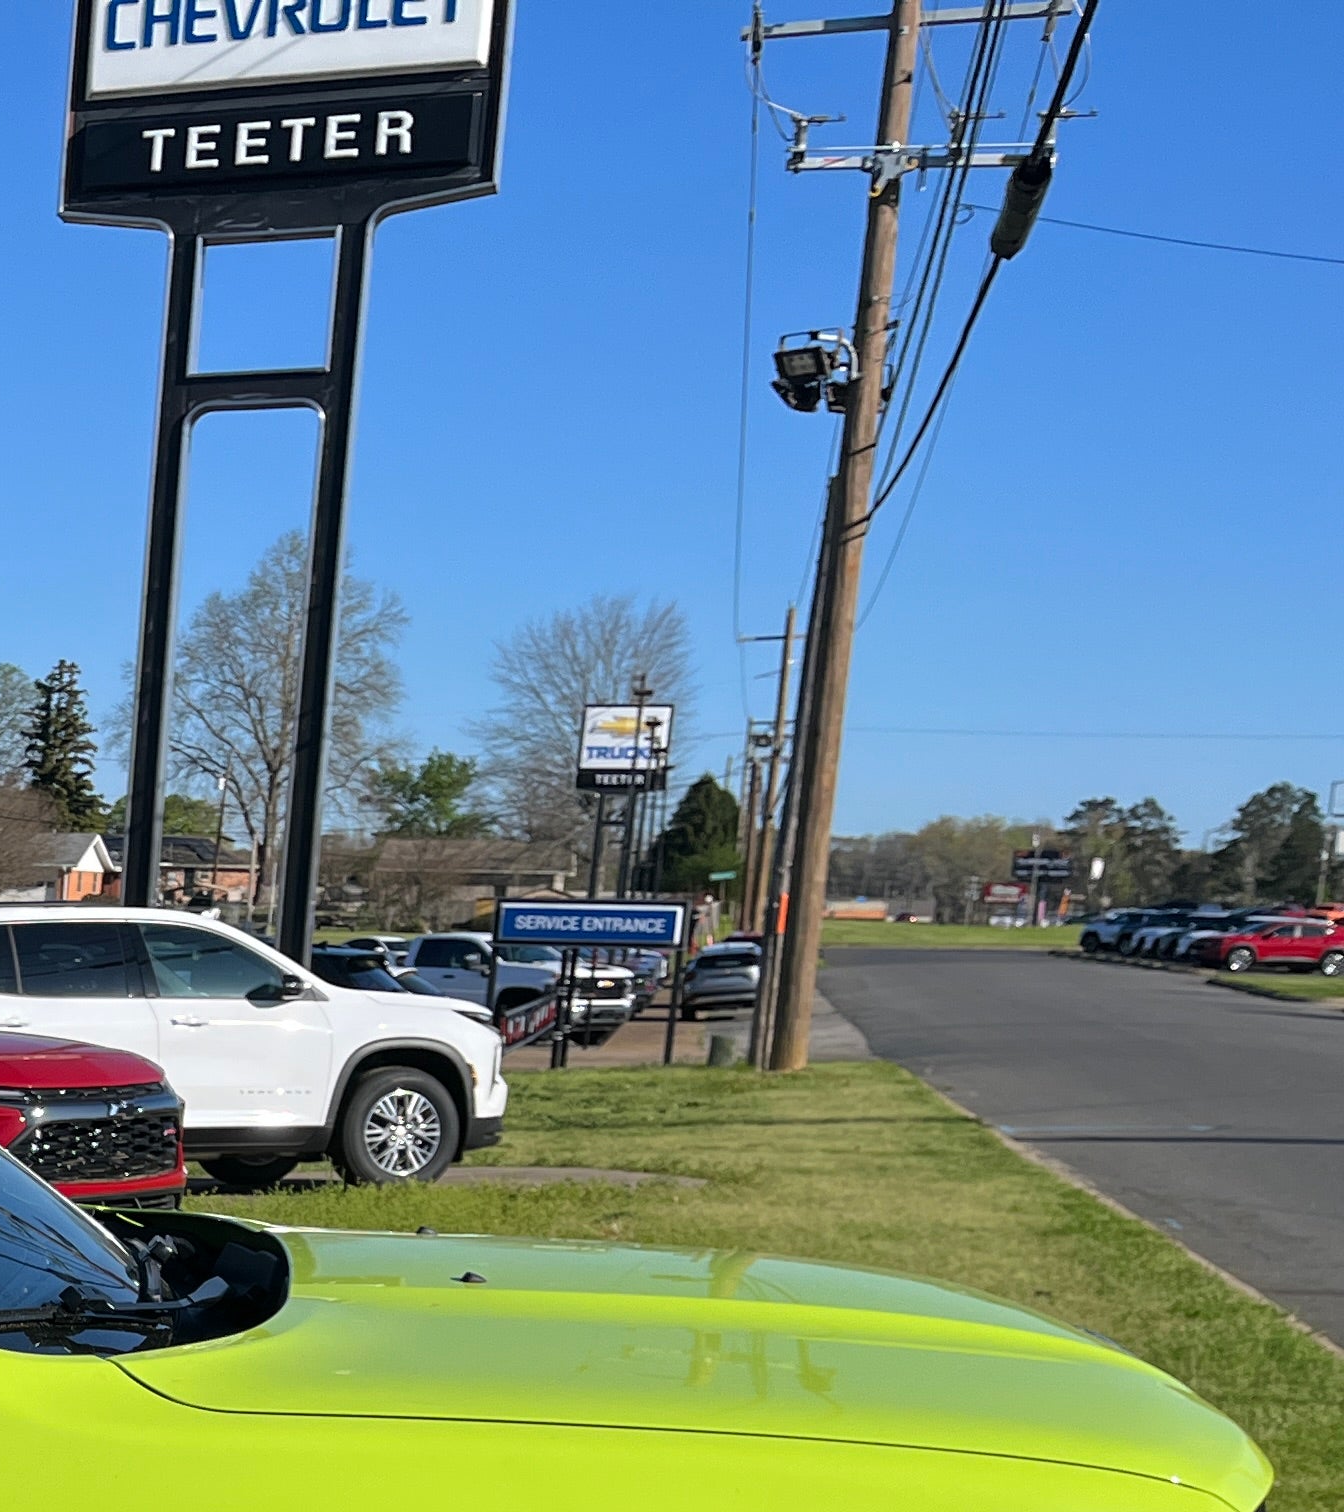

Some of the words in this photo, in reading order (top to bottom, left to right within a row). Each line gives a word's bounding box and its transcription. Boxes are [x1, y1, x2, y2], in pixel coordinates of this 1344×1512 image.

[142, 110, 414, 172] TEETER
[514, 914, 580, 931] SERVICE
[582, 917, 667, 934] ENTRANCE
